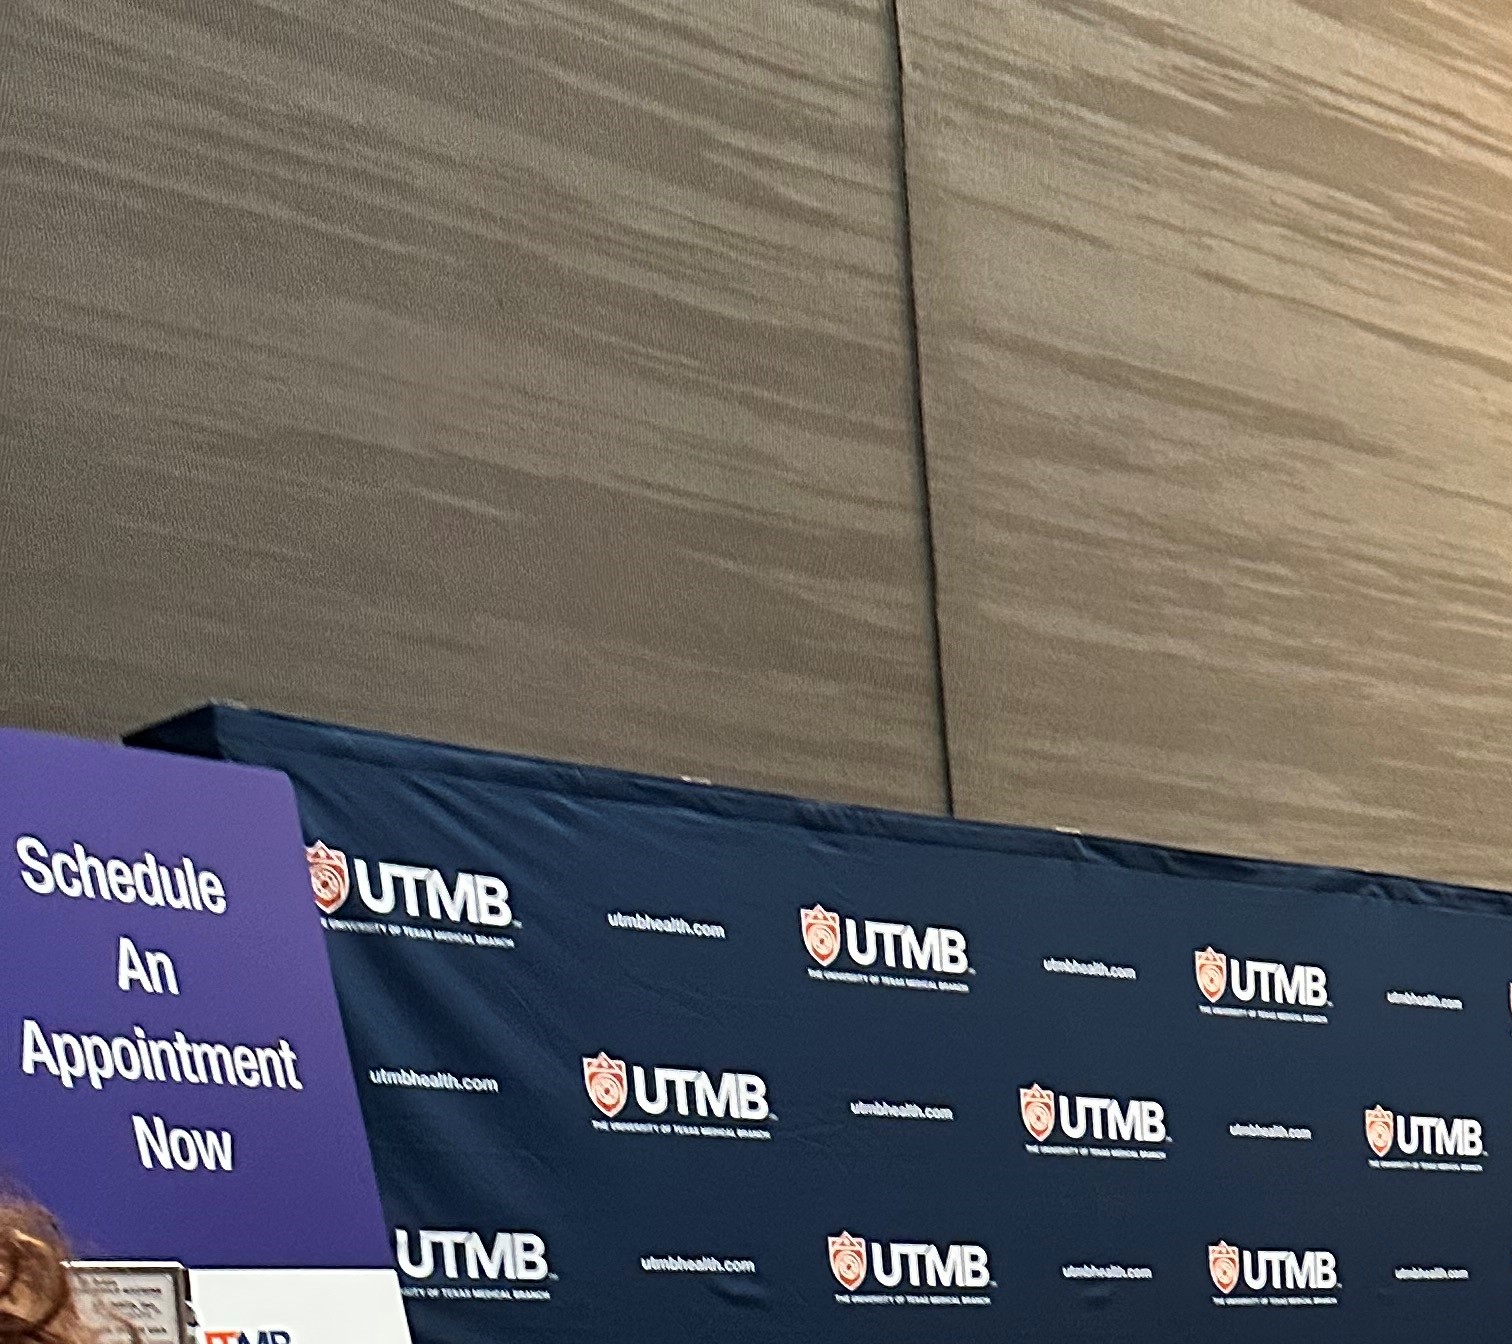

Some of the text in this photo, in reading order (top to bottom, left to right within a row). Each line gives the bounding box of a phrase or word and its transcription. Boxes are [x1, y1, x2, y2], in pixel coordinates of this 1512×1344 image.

[16, 836, 227, 914] Schedule
[354, 858, 512, 926] UTMB
[608, 911, 726, 939] utmbhealth.com
[846, 918, 968, 974] UTMB
[118, 936, 179, 995] An
[1230, 958, 1328, 1007] UTMB
[22, 1019, 303, 1090] Appointment
[369, 1068, 499, 1093] utmbhealth.com
[633, 1065, 769, 1120] UTMB
[850, 1101, 954, 1121] utmbhealth.com
[1059, 1095, 1166, 1142] UTMB
[1397, 1115, 1483, 1156] UTMB
[131, 1114, 233, 1171] Now
[395, 1228, 548, 1280] UTMB
[641, 1255, 756, 1273] utmbhealth.com
[871, 1242, 990, 1287] UTMB
[1243, 1250, 1337, 1290] UTMB
